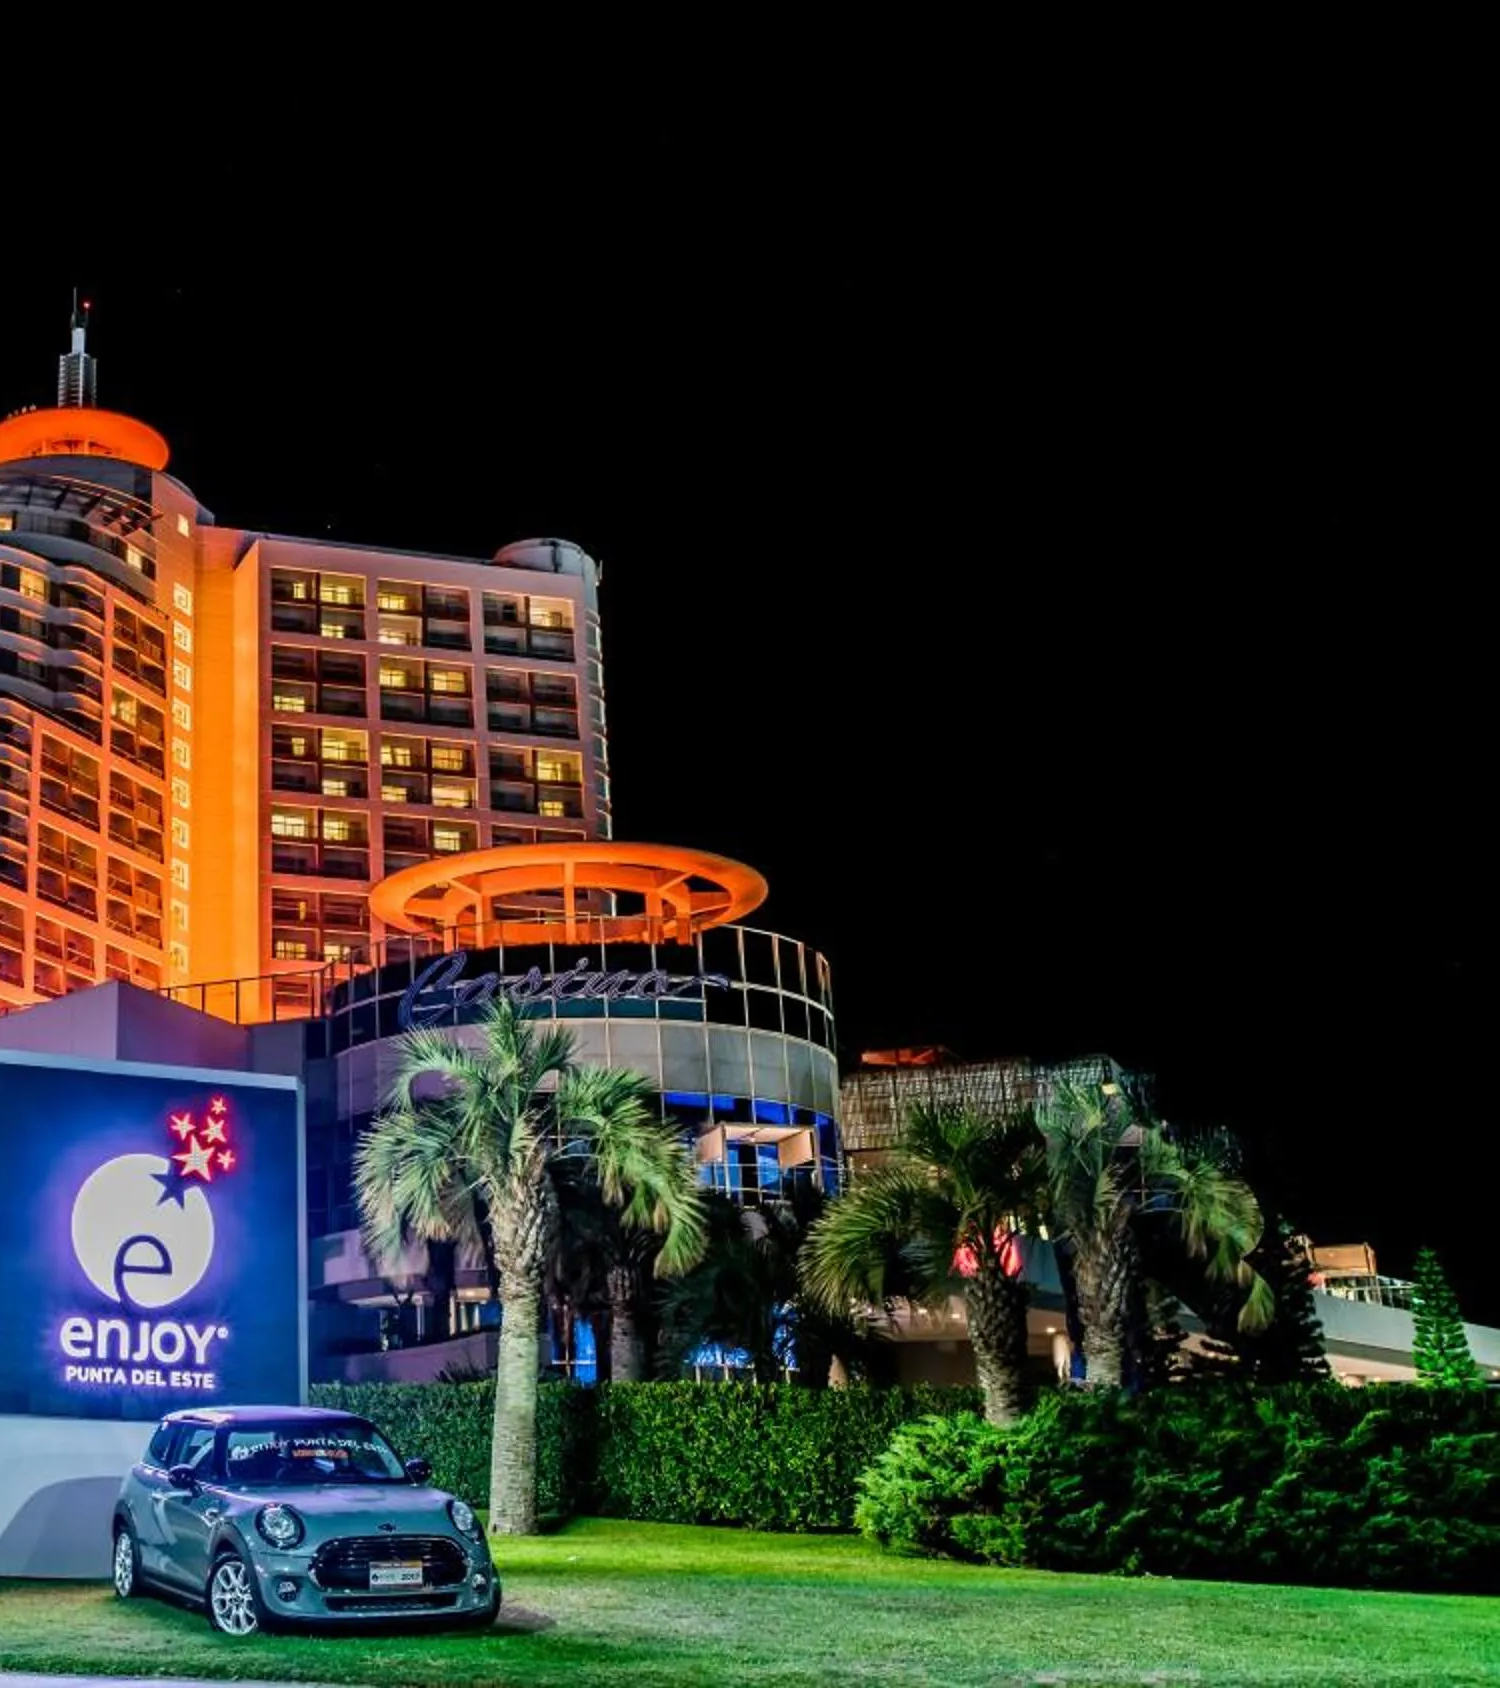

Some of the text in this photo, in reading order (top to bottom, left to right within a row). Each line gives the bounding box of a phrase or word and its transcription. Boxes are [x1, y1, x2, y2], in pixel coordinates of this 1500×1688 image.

[66, 1365, 216, 1389] PUNTA DEL ESTE
